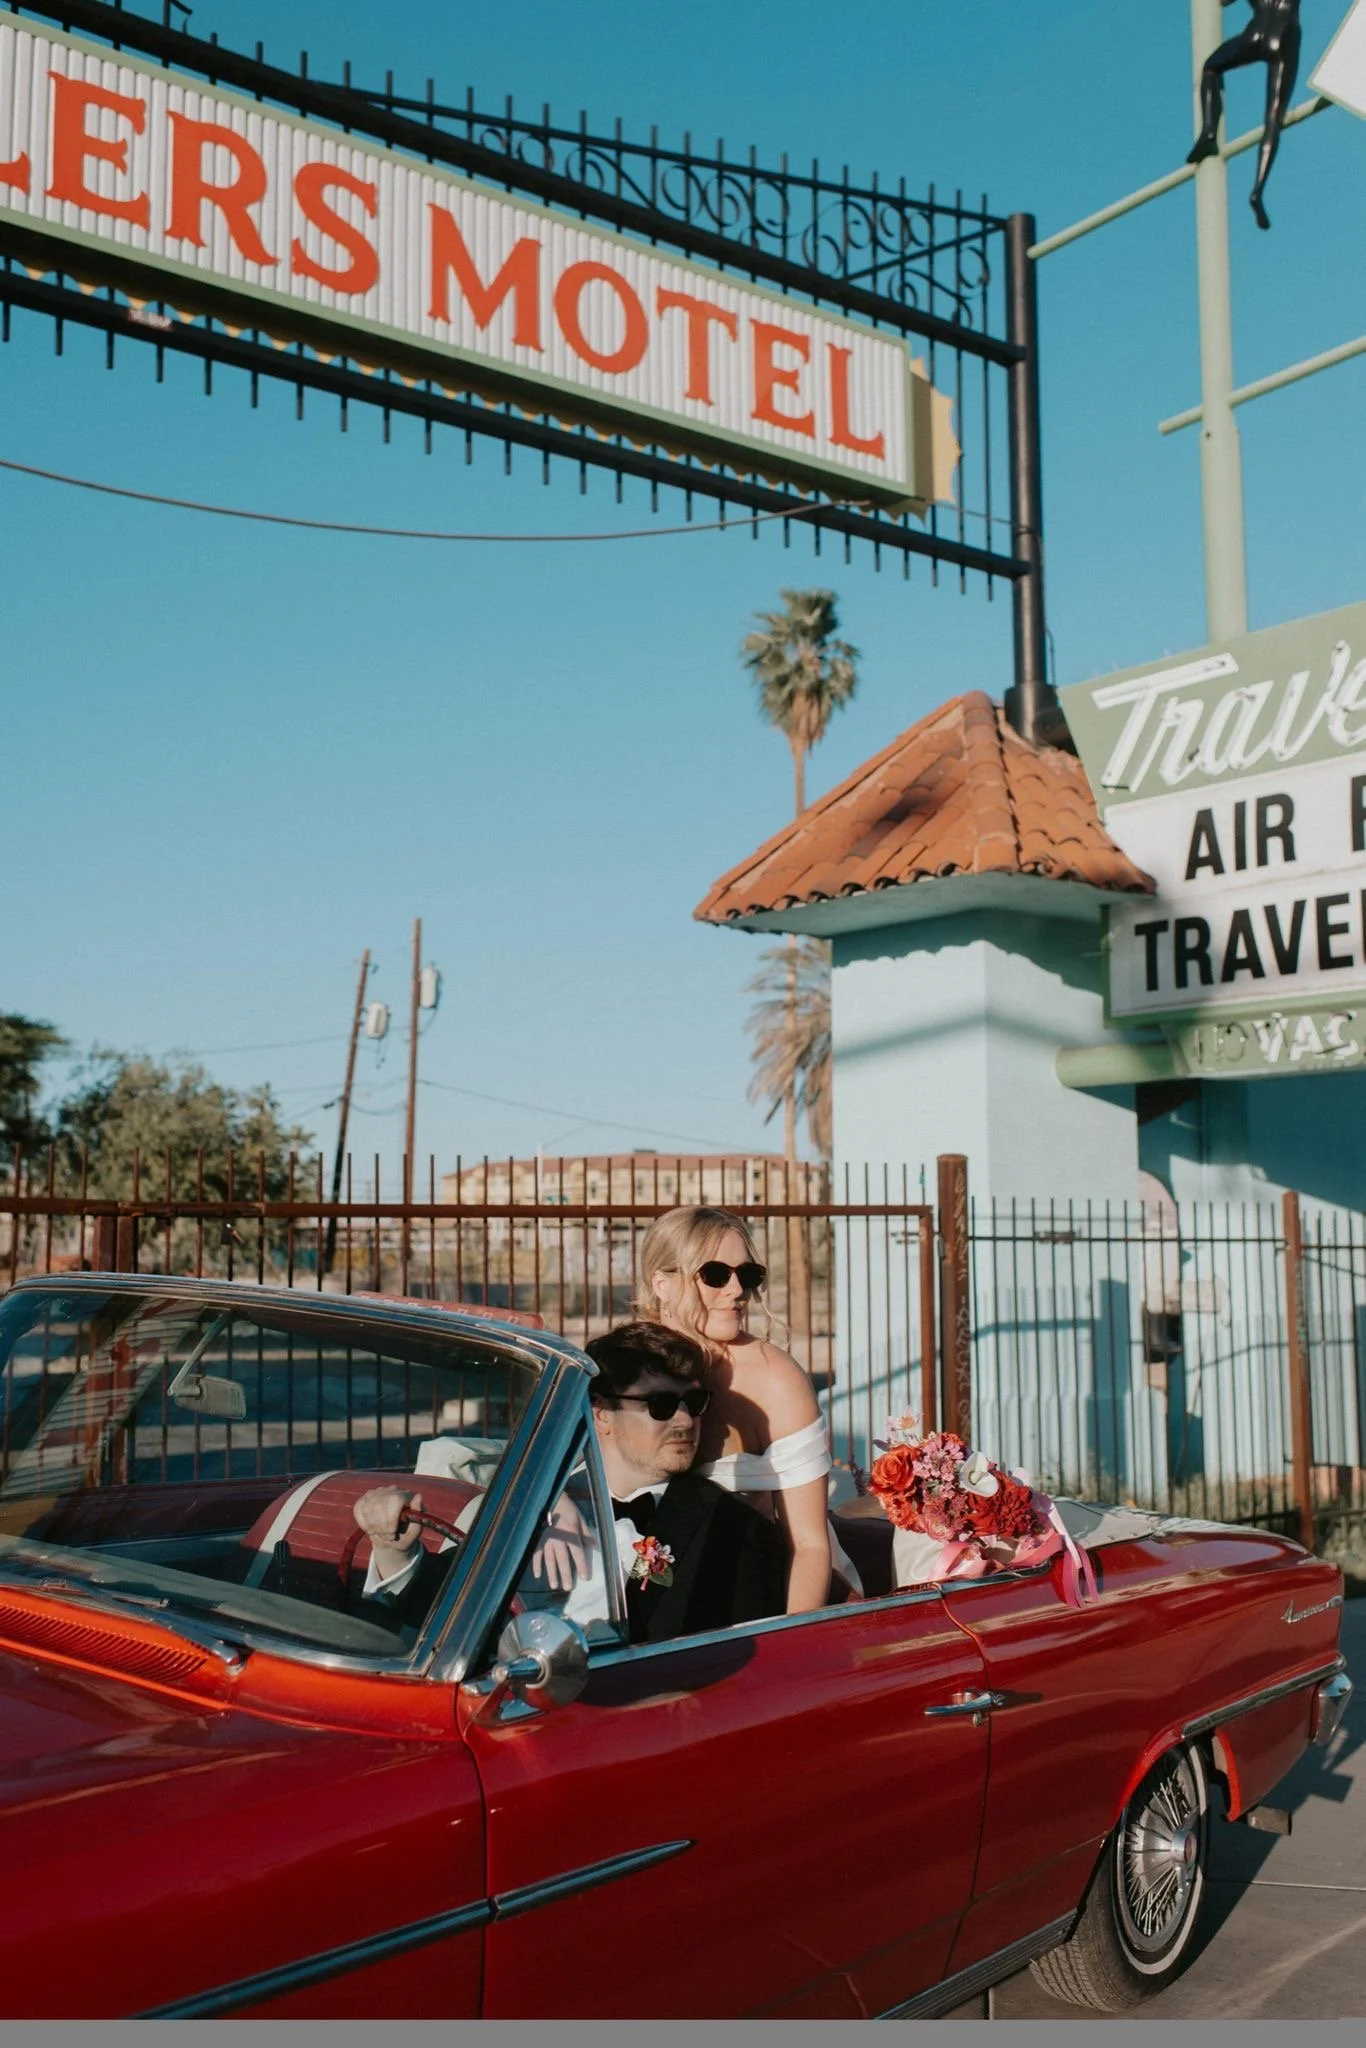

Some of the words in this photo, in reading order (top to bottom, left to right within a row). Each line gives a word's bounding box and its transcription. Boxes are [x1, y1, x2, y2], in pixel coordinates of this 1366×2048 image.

[426, 202, 886, 461] MOTEL
[1184, 791, 1297, 881] AIR
[1134, 888, 1366, 992] TRAVE
